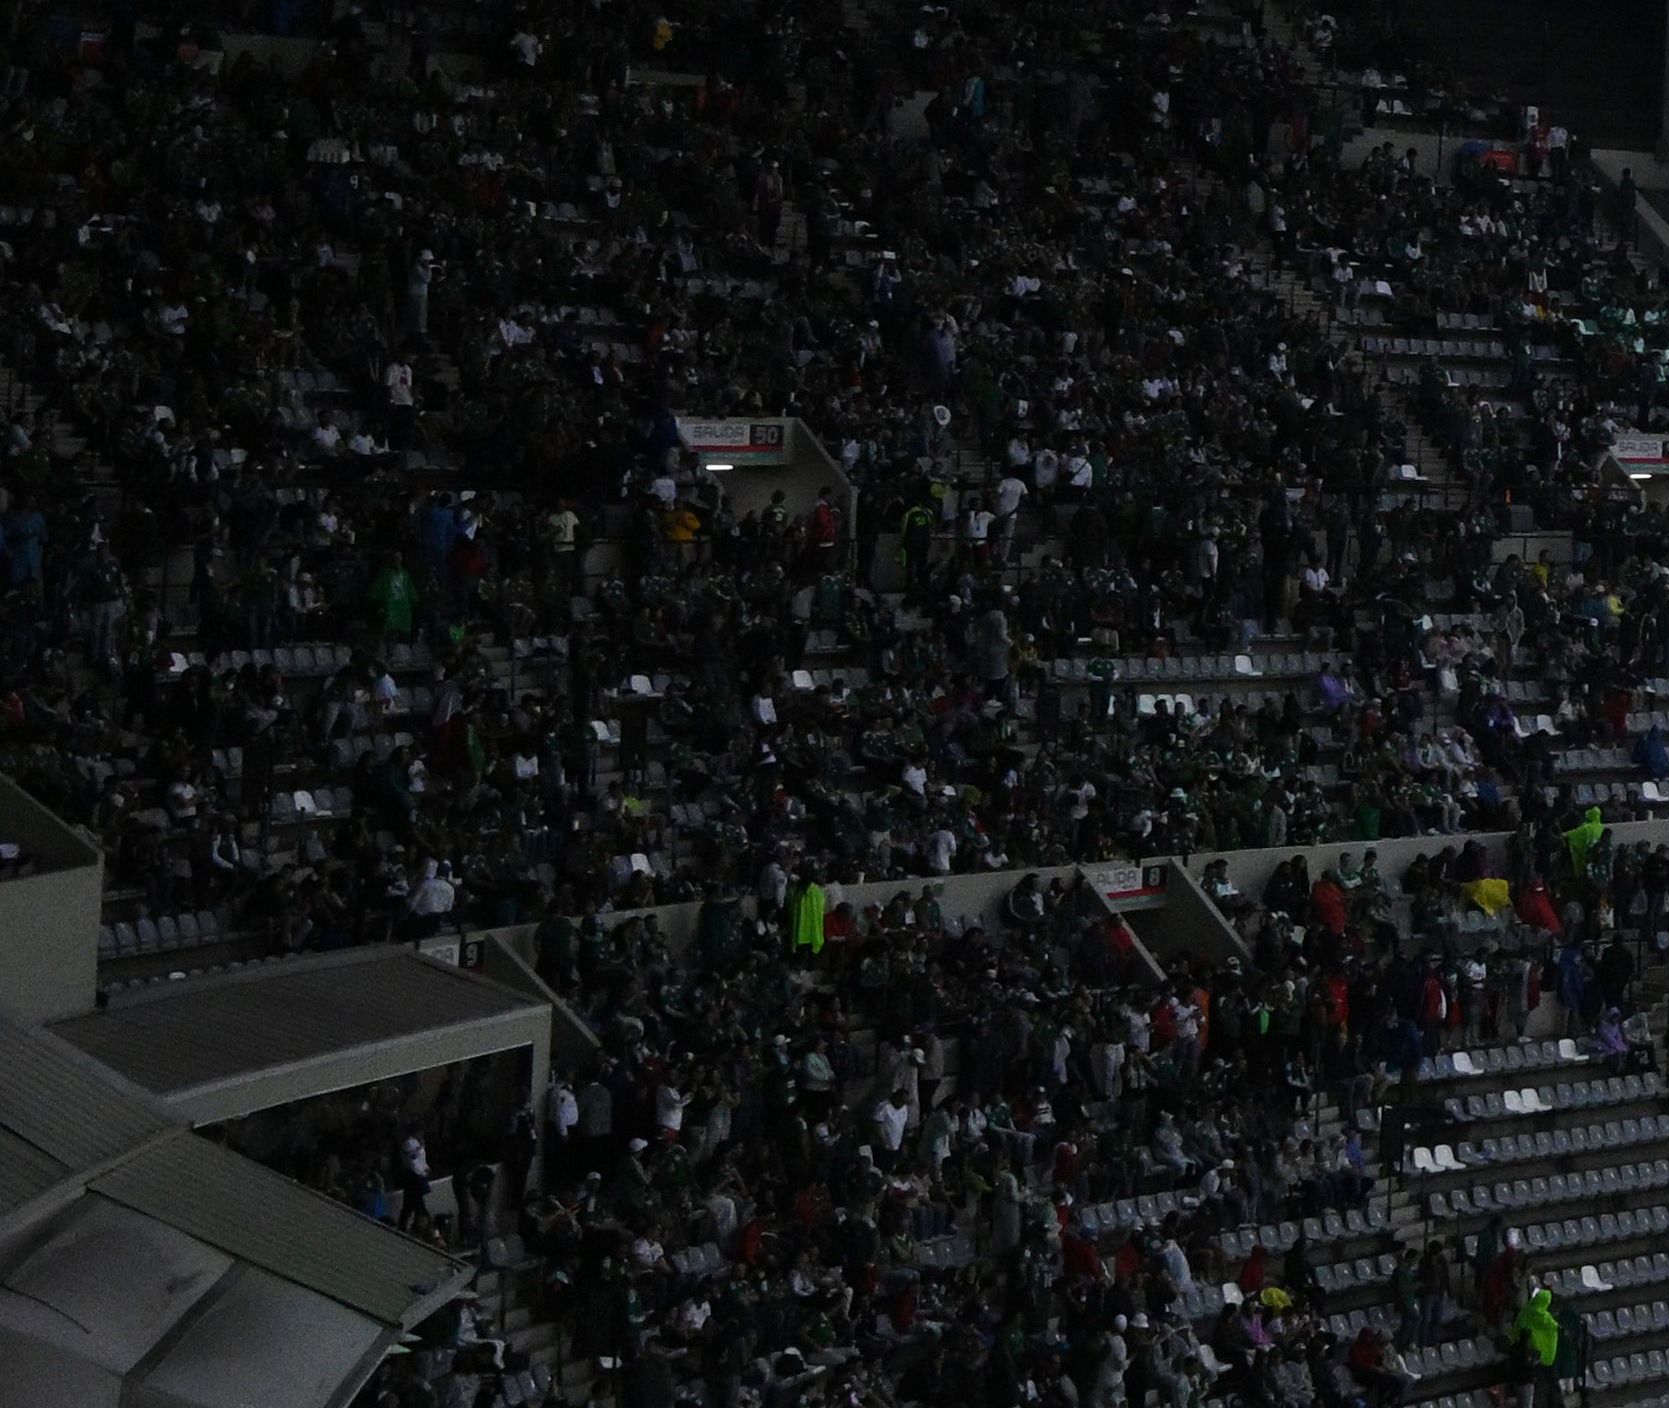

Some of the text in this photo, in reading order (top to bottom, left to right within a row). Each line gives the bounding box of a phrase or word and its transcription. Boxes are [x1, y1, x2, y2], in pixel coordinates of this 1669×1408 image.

[694, 426, 779, 445] SALIDA 50
[1149, 867, 1161, 886] 8
[465, 943, 478, 967] 9
